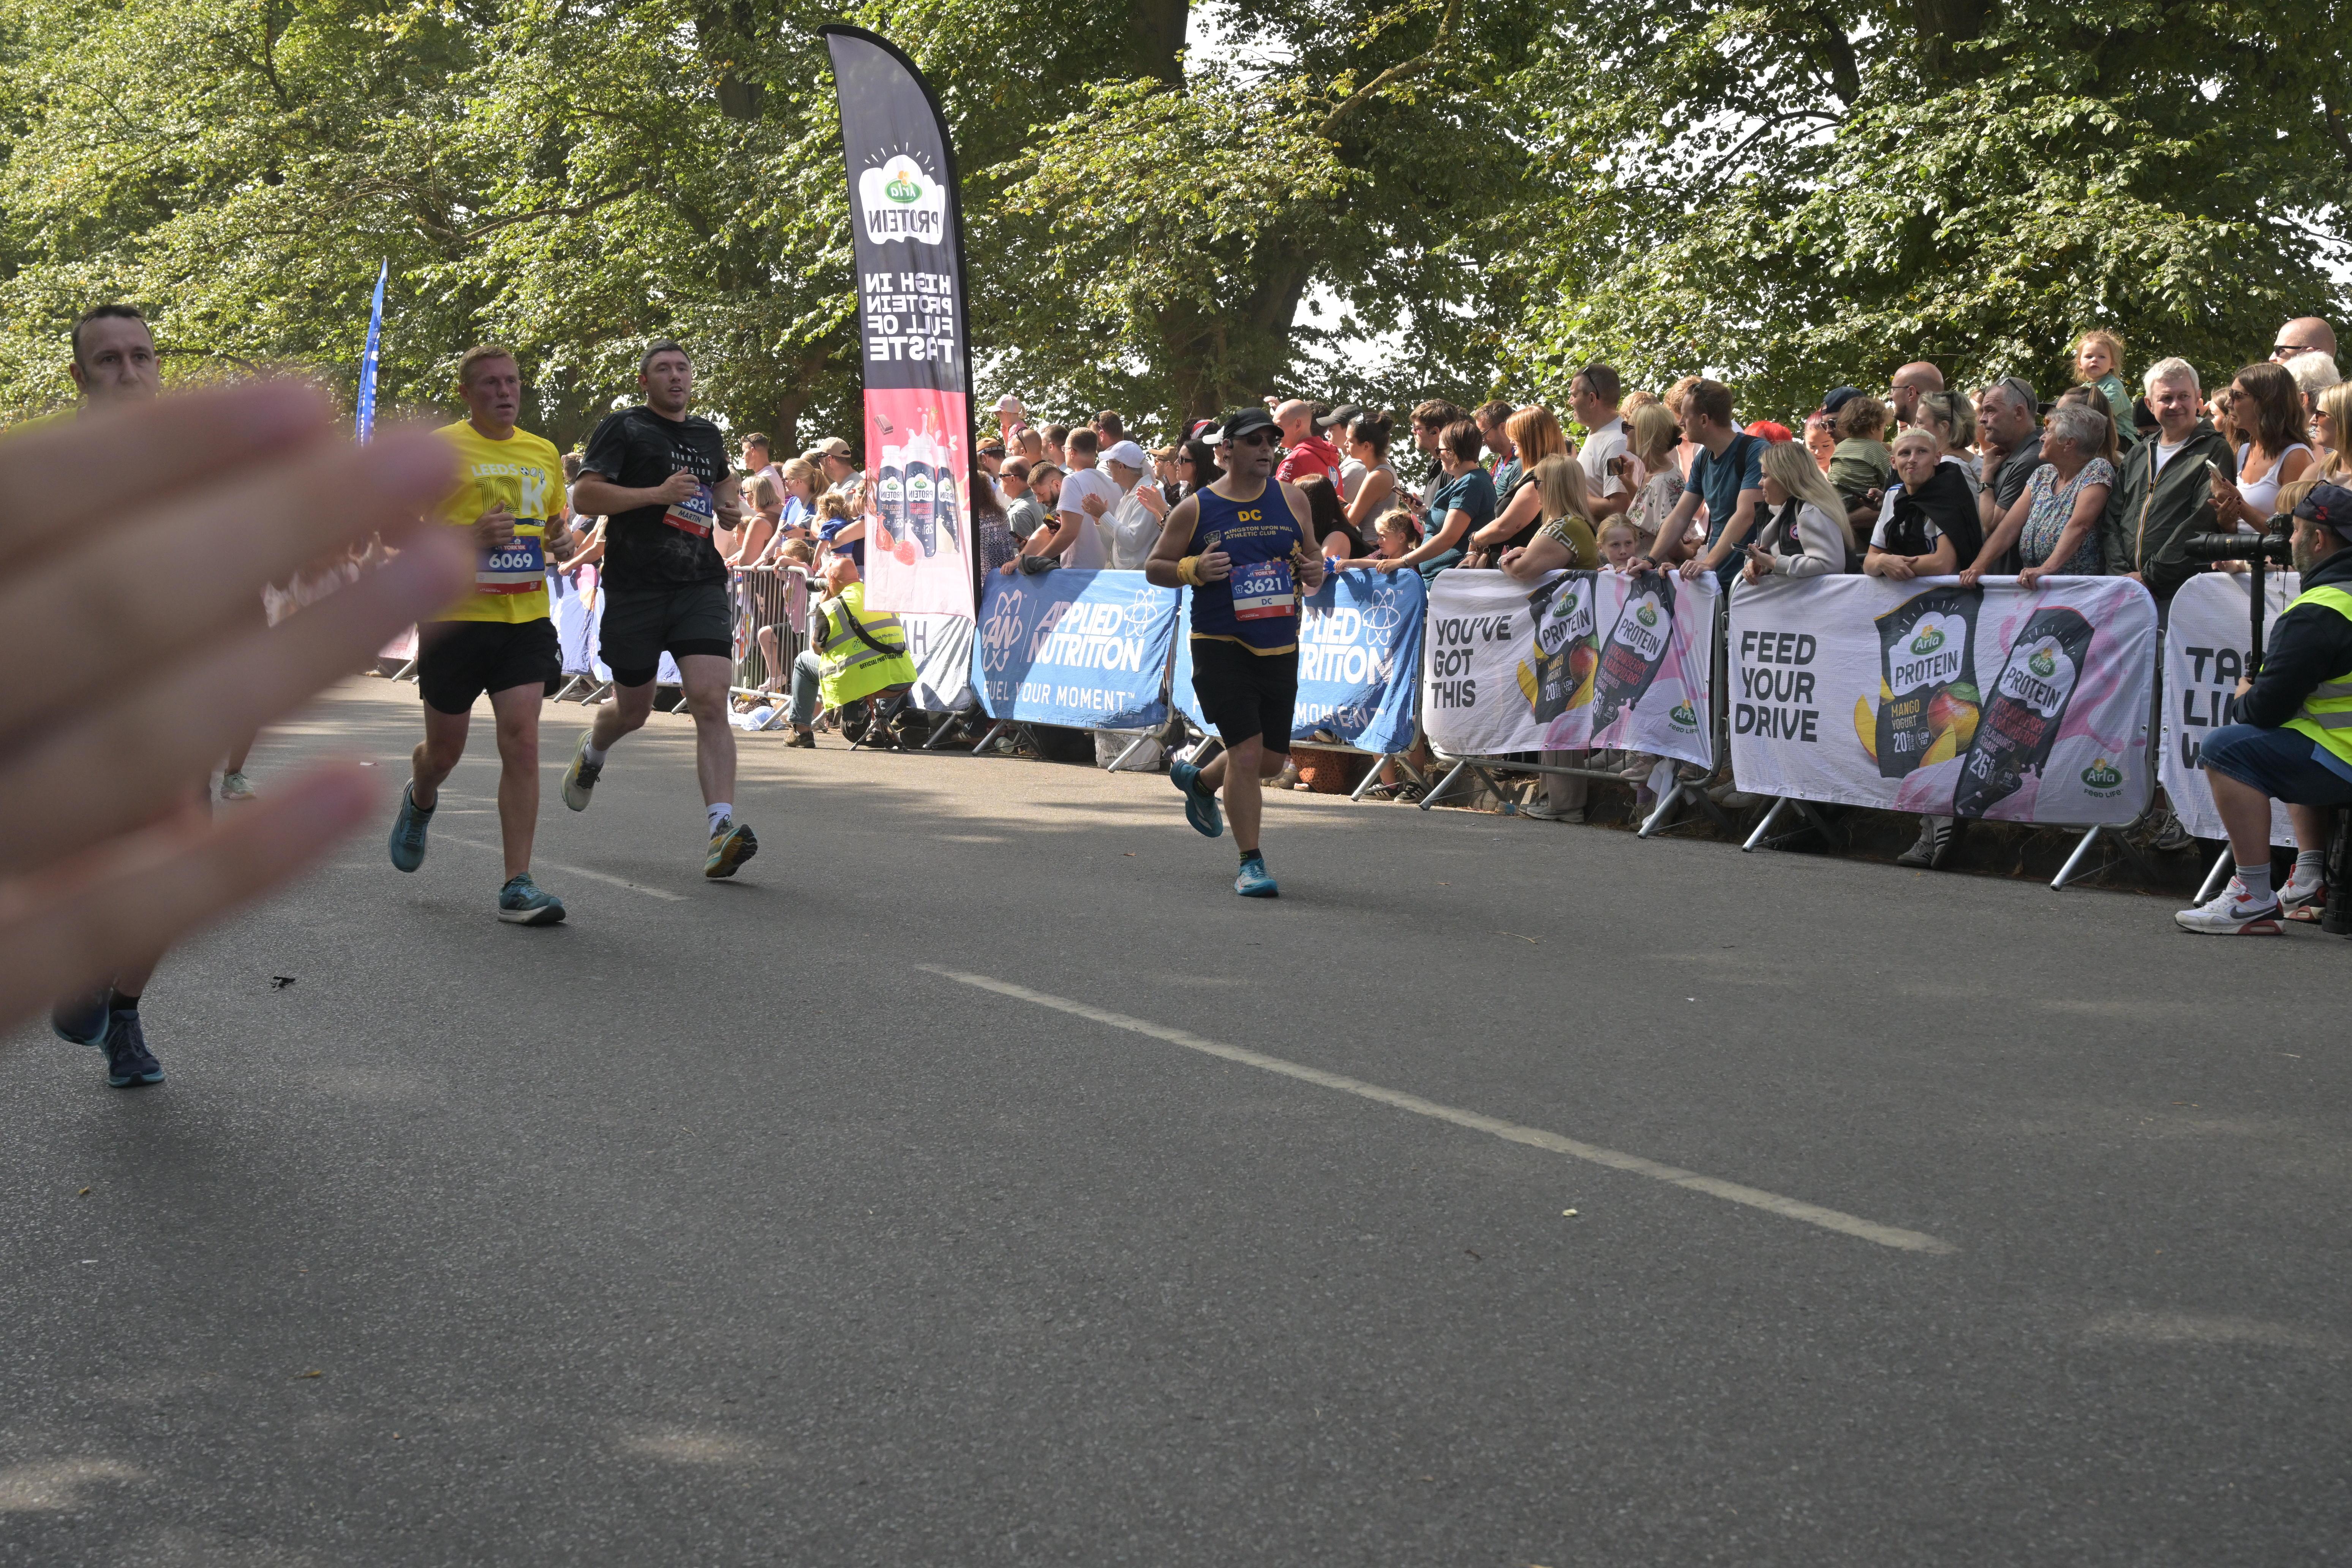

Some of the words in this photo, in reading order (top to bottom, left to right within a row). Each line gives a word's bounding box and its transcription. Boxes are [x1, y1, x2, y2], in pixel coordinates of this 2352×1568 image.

[672, 451, 710, 464] RUNNING
[471, 463, 518, 477] LEEDS
[672, 463, 710, 476] DIVSION
[682, 498, 706, 512] 93
[678, 510, 702, 523] MARTIN
[1238, 509, 1262, 522] DC
[1224, 526, 1259, 535] KINGSTON
[489, 553, 533, 568] 6069
[1244, 578, 1282, 594] 3621
[1554, 598, 1574, 614] Arla
[1035, 601, 1123, 636] APPLIED
[1298, 607, 1361, 644] PLIED
[1639, 609, 1654, 623] Arla
[1436, 615, 1513, 646] YOU'VE
[1543, 607, 1590, 648] PROTEIN
[1618, 618, 1661, 655] PROTEIN
[1026, 631, 1145, 672] NUTRITION
[1740, 631, 1816, 665] FEED
[1915, 635, 1939, 651] Arla
[859, 659, 877, 669] OFFICIAL
[877, 653, 903, 663] PHOTOGRAPHER
[1298, 643, 1393, 685] RITION
[1434, 648, 1473, 678] GOT
[1547, 654, 1563, 672] MANGO
[1608, 644, 1649, 675] STRAWBERRY
[1895, 650, 1958, 687] PROTEIN
[2031, 657, 2051, 673] Arla
[1547, 667, 1561, 683] YOGURT
[1563, 679, 1573, 688] LOW
[1596, 677, 1608, 692] SHAKE
[1599, 667, 1620, 689] FLAVOURED
[983, 680, 1009, 701] FUEL
[1015, 681, 1051, 705] YOUR
[1431, 680, 1476, 708] THIS
[1546, 683, 1555, 702] 20
[1742, 667, 1815, 704] YOUR
[2003, 666, 2061, 710] PROTEIN
[1593, 688, 1602, 714] 26
[1892, 699, 1920, 718] MANGO
[1674, 708, 1695, 721] Arla
[1735, 703, 1819, 743] DRIVE
[1892, 715, 1917, 730] YOGURT
[1893, 732, 1907, 753] 20
[1918, 731, 1929, 740] LOW
[1984, 725, 2016, 752] FLAVOURED
[1980, 735, 1998, 756] SHAKE
[1969, 748, 1990, 779] 26
[2004, 771, 2013, 780] NO
[2087, 770, 2115, 782] Arla
